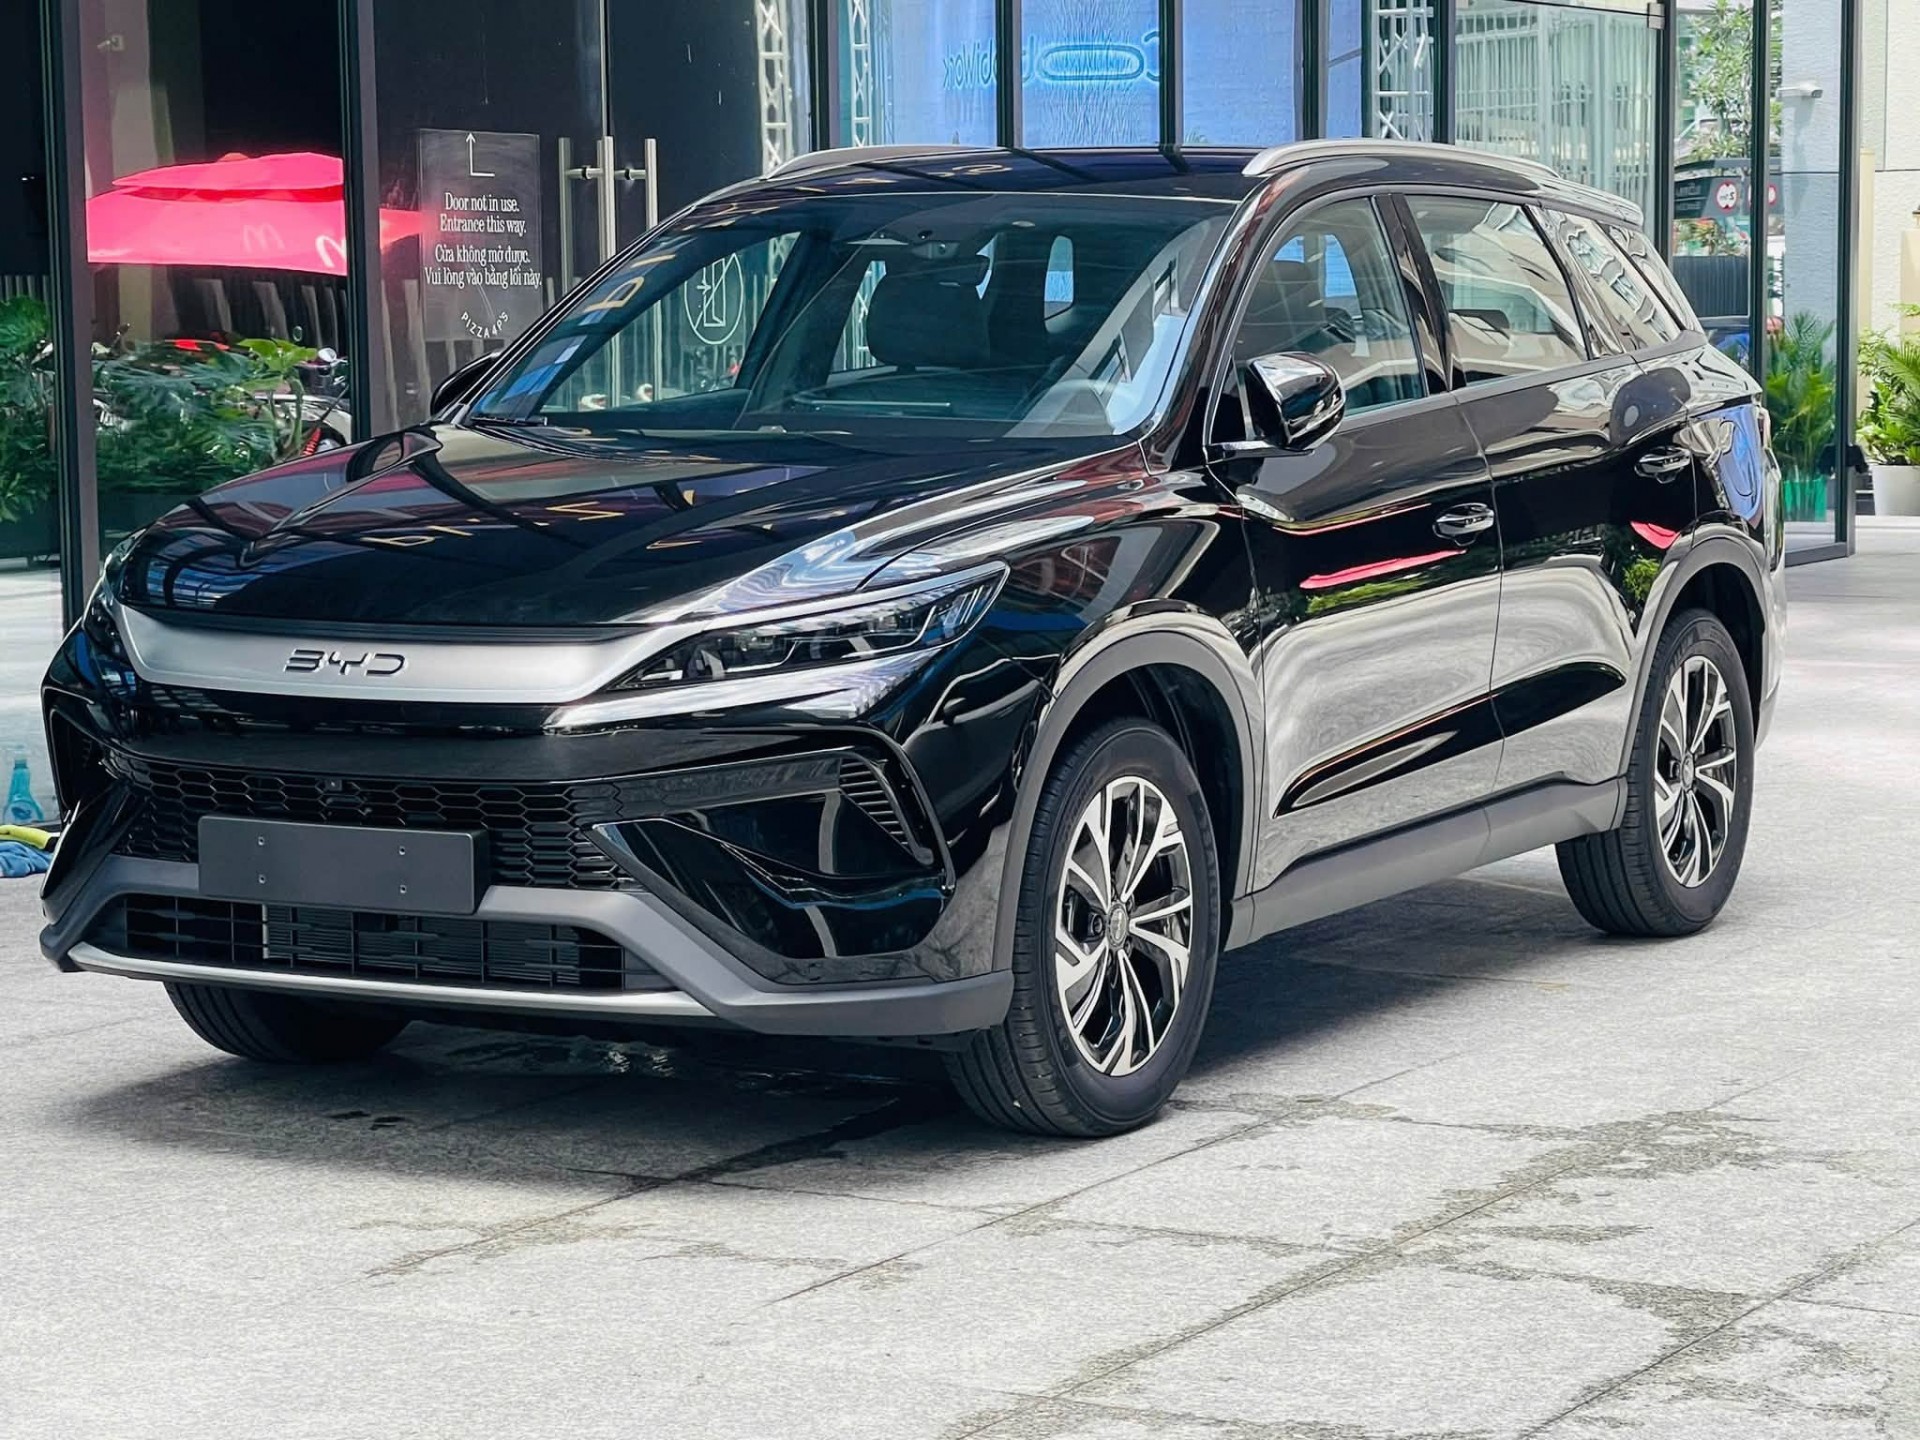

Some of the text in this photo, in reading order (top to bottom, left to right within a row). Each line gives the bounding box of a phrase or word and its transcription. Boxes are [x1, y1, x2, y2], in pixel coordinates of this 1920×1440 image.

[445, 192, 520, 212] Door not in use.
[440, 213, 527, 237] Entrance this way.
[456, 244, 486, 267] không
[425, 267, 441, 285] Vui
[443, 267, 465, 289] lòng
[466, 268, 483, 285] vào
[485, 264, 508, 289] bằng
[524, 268, 542, 289] này.
[461, 311, 490, 339] PIZZA
[283, 648, 408, 676] BYD
